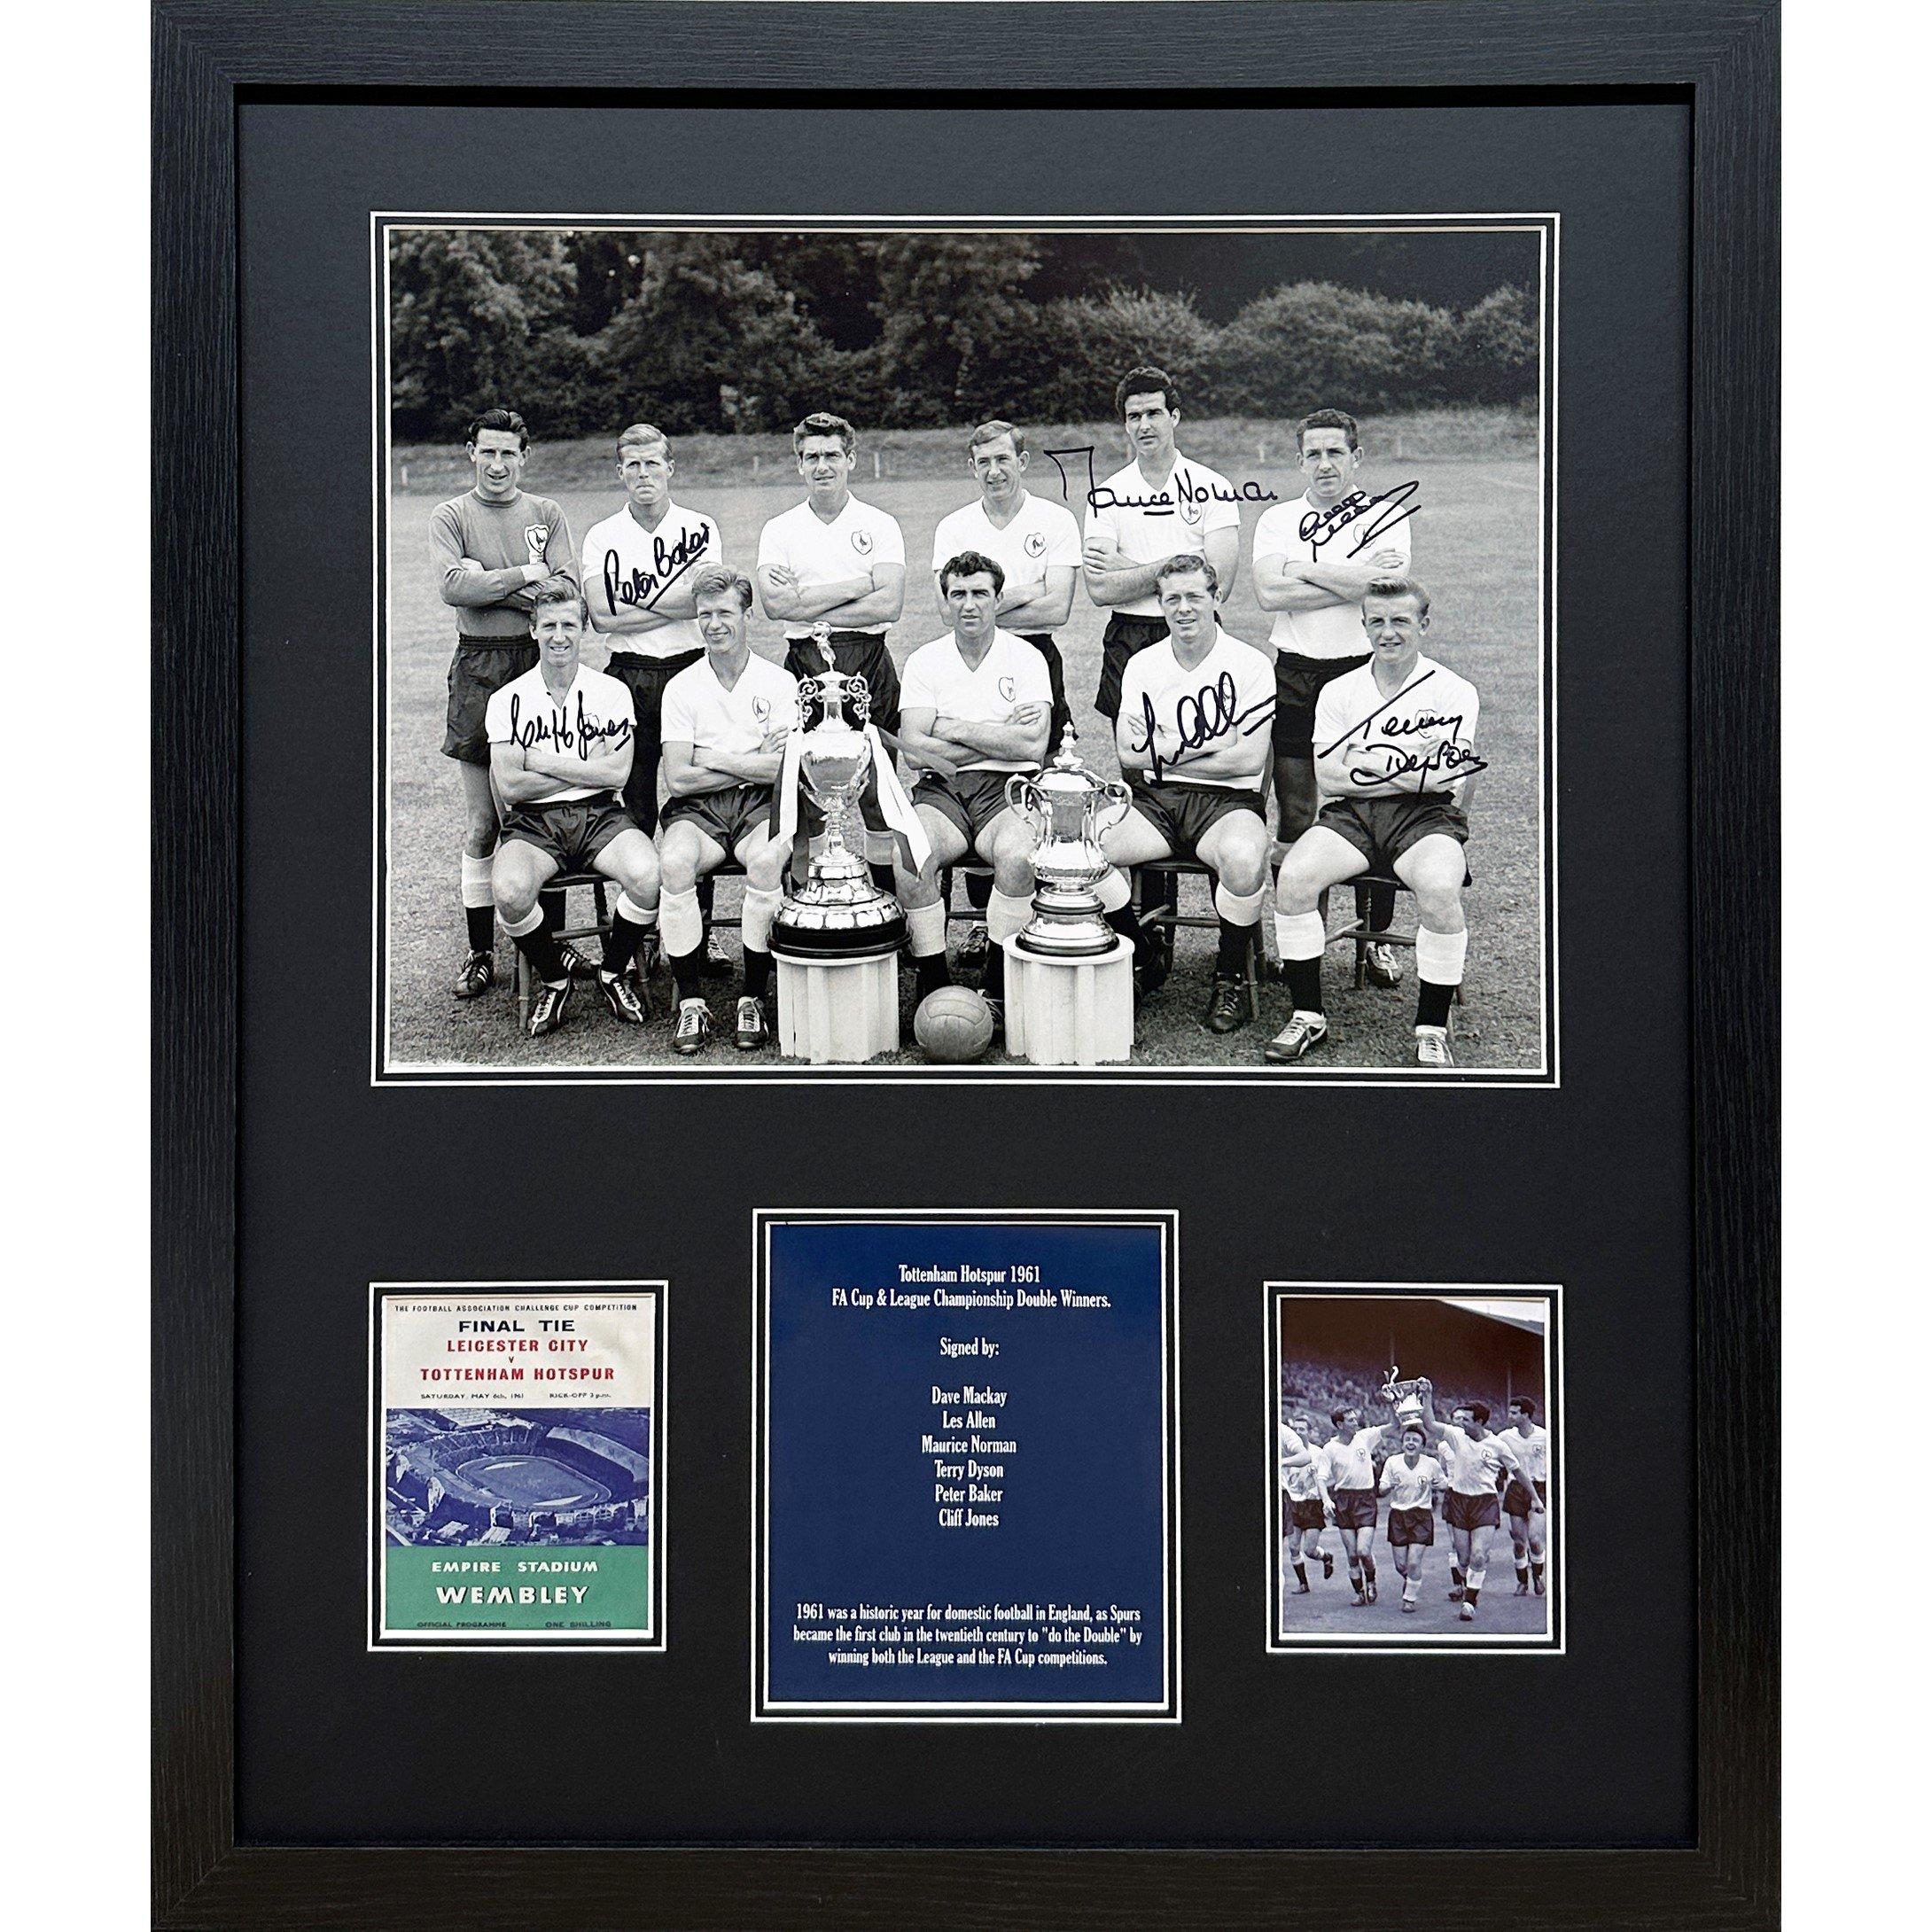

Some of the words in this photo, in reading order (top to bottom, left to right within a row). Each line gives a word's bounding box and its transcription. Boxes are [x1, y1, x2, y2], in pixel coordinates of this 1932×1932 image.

[898, 1264, 958, 1282] Tottenham
[960, 1265, 1007, 1286] Hotspur
[1010, 1265, 1040, 1283] 1961
[831, 1288, 848, 1306] FA
[851, 1288, 874, 1310] Cup
[876, 1288, 887, 1306] &
[889, 1288, 931, 1310] League
[933, 1288, 1014, 1311] Championship
[1017, 1289, 1058, 1307] Double
[1060, 1289, 1111, 1308] Winners.
[459, 1320, 526, 1333] FINAL
[538, 1320, 575, 1332] TIE
[447, 1339, 539, 1352] LEICESTER
[548, 1339, 588, 1352] CITY
[939, 1336, 979, 1359] Signed
[981, 1336, 1000, 1359] by:
[420, 1367, 524, 1381] TOTTENHAM
[534, 1367, 614, 1381] HOTSPUR
[931, 1385, 961, 1405] Dave
[962, 1385, 1008, 1407] Mackay
[942, 1410, 963, 1429] Les
[965, 1410, 996, 1429] Allen
[922, 1435, 969, 1453] Maurice
[970, 1434, 1017, 1453] Norman
[934, 1459, 965, 1482] Terry
[967, 1459, 1004, 1481] Dyson
[935, 1484, 966, 1503] Peter
[968, 1484, 1004, 1503] Baker
[939, 1507, 964, 1527] Cliff
[964, 1507, 1000, 1527] Jones
[432, 1562, 501, 1573] EMPIRE
[518, 1561, 598, 1573] STADIUM
[435, 1585, 588, 1604] WEMBLEY
[797, 1602, 824, 1620] 1961
[827, 1608, 848, 1620] was
[850, 1609, 858, 1620] a
[859, 1602, 900, 1620] historic
[900, 1609, 925, 1623] year
[926, 1603, 943, 1621] for
[944, 1603, 992, 1621] domestic
[993, 1603, 1033, 1621] football
[1035, 1604, 1047, 1621] in
[1048, 1603, 1094, 1624] England,
[1095, 1609, 1109, 1621] as
[1110, 1604, 1141, 1624] Spurs
[793, 1624, 834, 1641] became
[835, 1624, 853, 1641] the
[854, 1624, 876, 1642] first
[878, 1624, 901, 1642] club
[903, 1626, 915, 1642] in
[915, 1625, 933, 1642] the
[935, 1625, 984, 1642] twentieth
[985, 1628, 1025, 1645] century
[1027, 1628, 1040, 1643] to
[1041, 1626, 1062, 1643] "do
[1063, 1626, 1081, 1643] the
[1083, 1625, 1127, 1643] Double"
[1129, 1626, 1142, 1646] by
[828, 1648, 869, 1667] winning
[871, 1647, 896, 1664] both
[897, 1648, 915, 1664] the
[916, 1647, 954, 1667] League
[956, 1648, 977, 1664] and
[978, 1648, 995, 1664] the
[997, 1648, 1013, 1665] FA
[1014, 1648, 1036, 1668] Cup
[1037, 1648, 1108, 1668] competitions.
